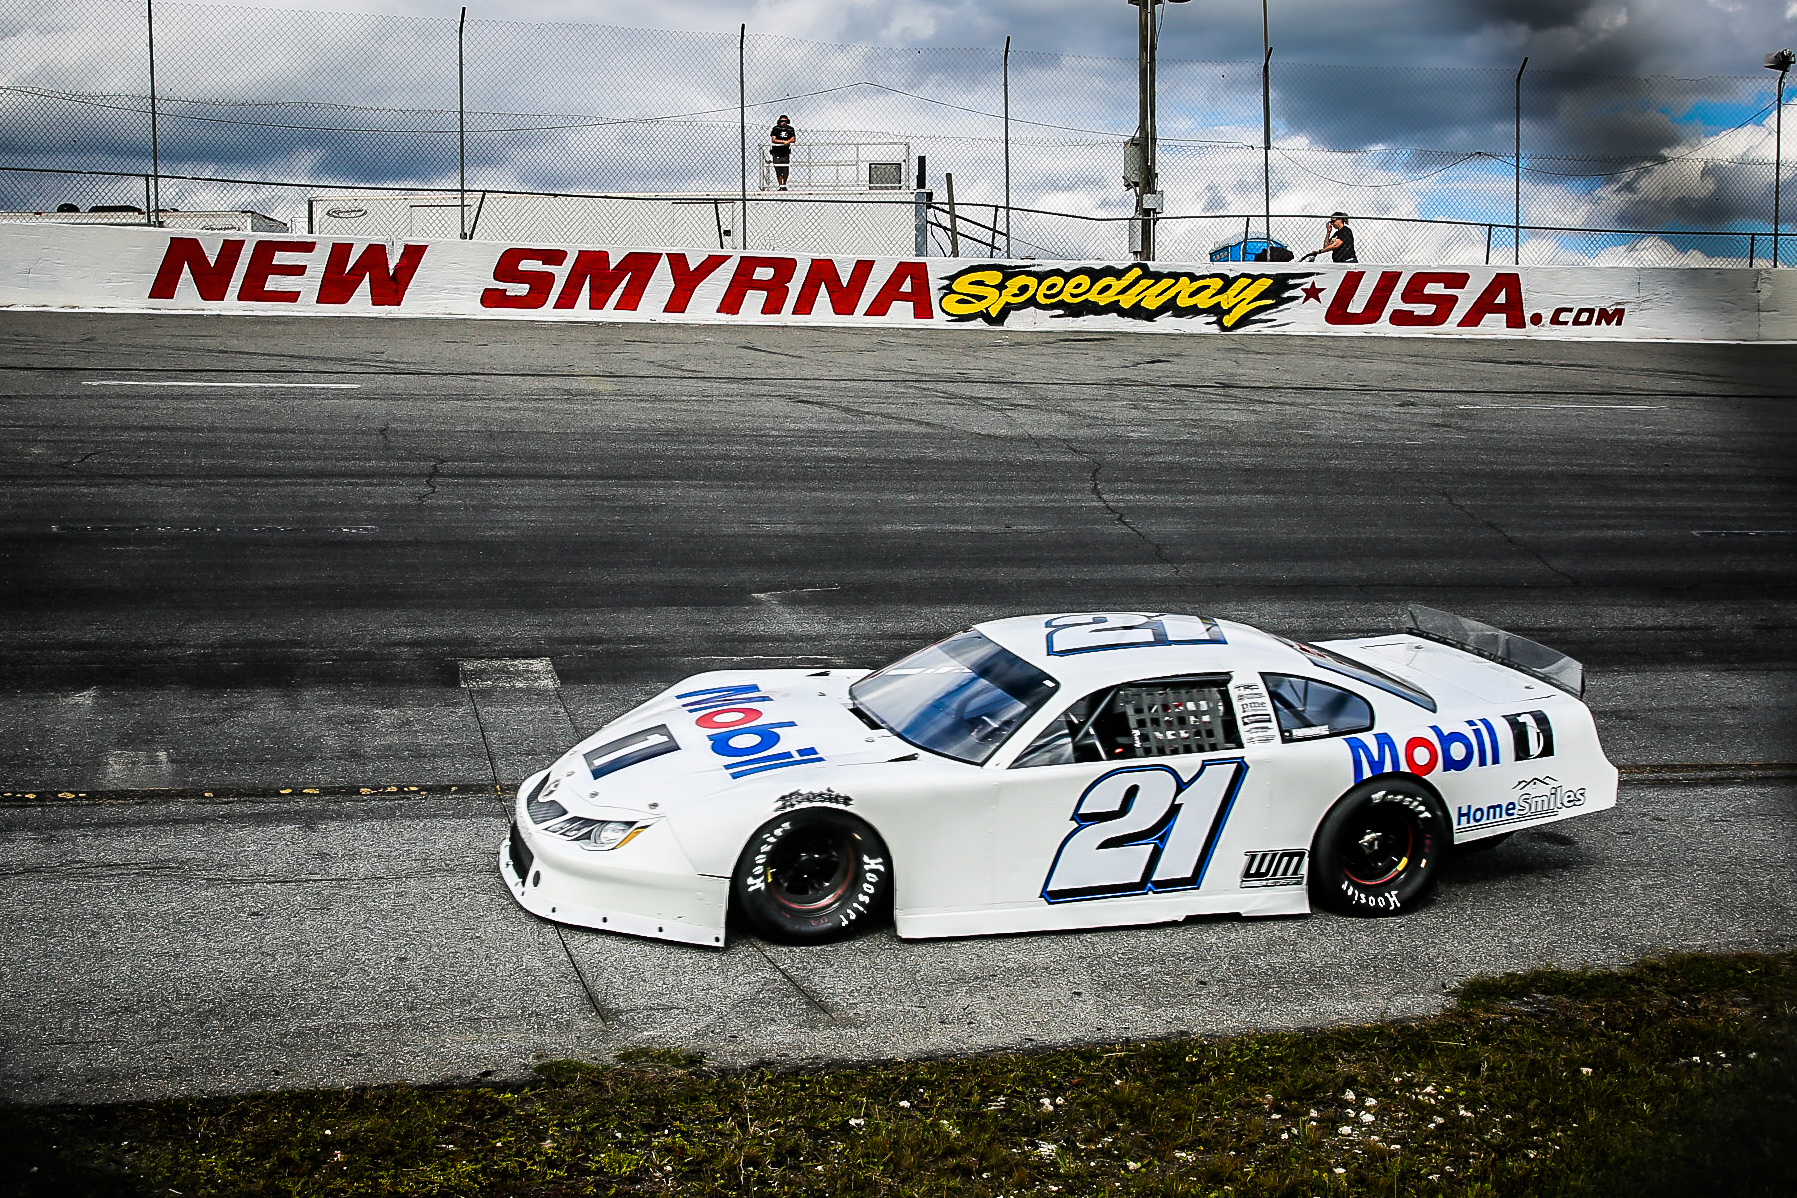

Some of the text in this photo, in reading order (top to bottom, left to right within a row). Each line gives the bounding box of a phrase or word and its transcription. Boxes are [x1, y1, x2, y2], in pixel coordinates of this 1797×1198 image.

[149, 236, 428, 307] NEW
[481, 247, 934, 320] SMYRNA
[941, 265, 1277, 329] Speedway
[1044, 611, 1228, 657] 21
[591, 733, 671, 768] 1
[675, 683, 827, 780] Mobil
[1343, 712, 1544, 785] Mobil 1
[1040, 757, 1250, 905] 21
[838, 854, 886, 928] Hoosier
[1340, 880, 1402, 911] Hoosier
